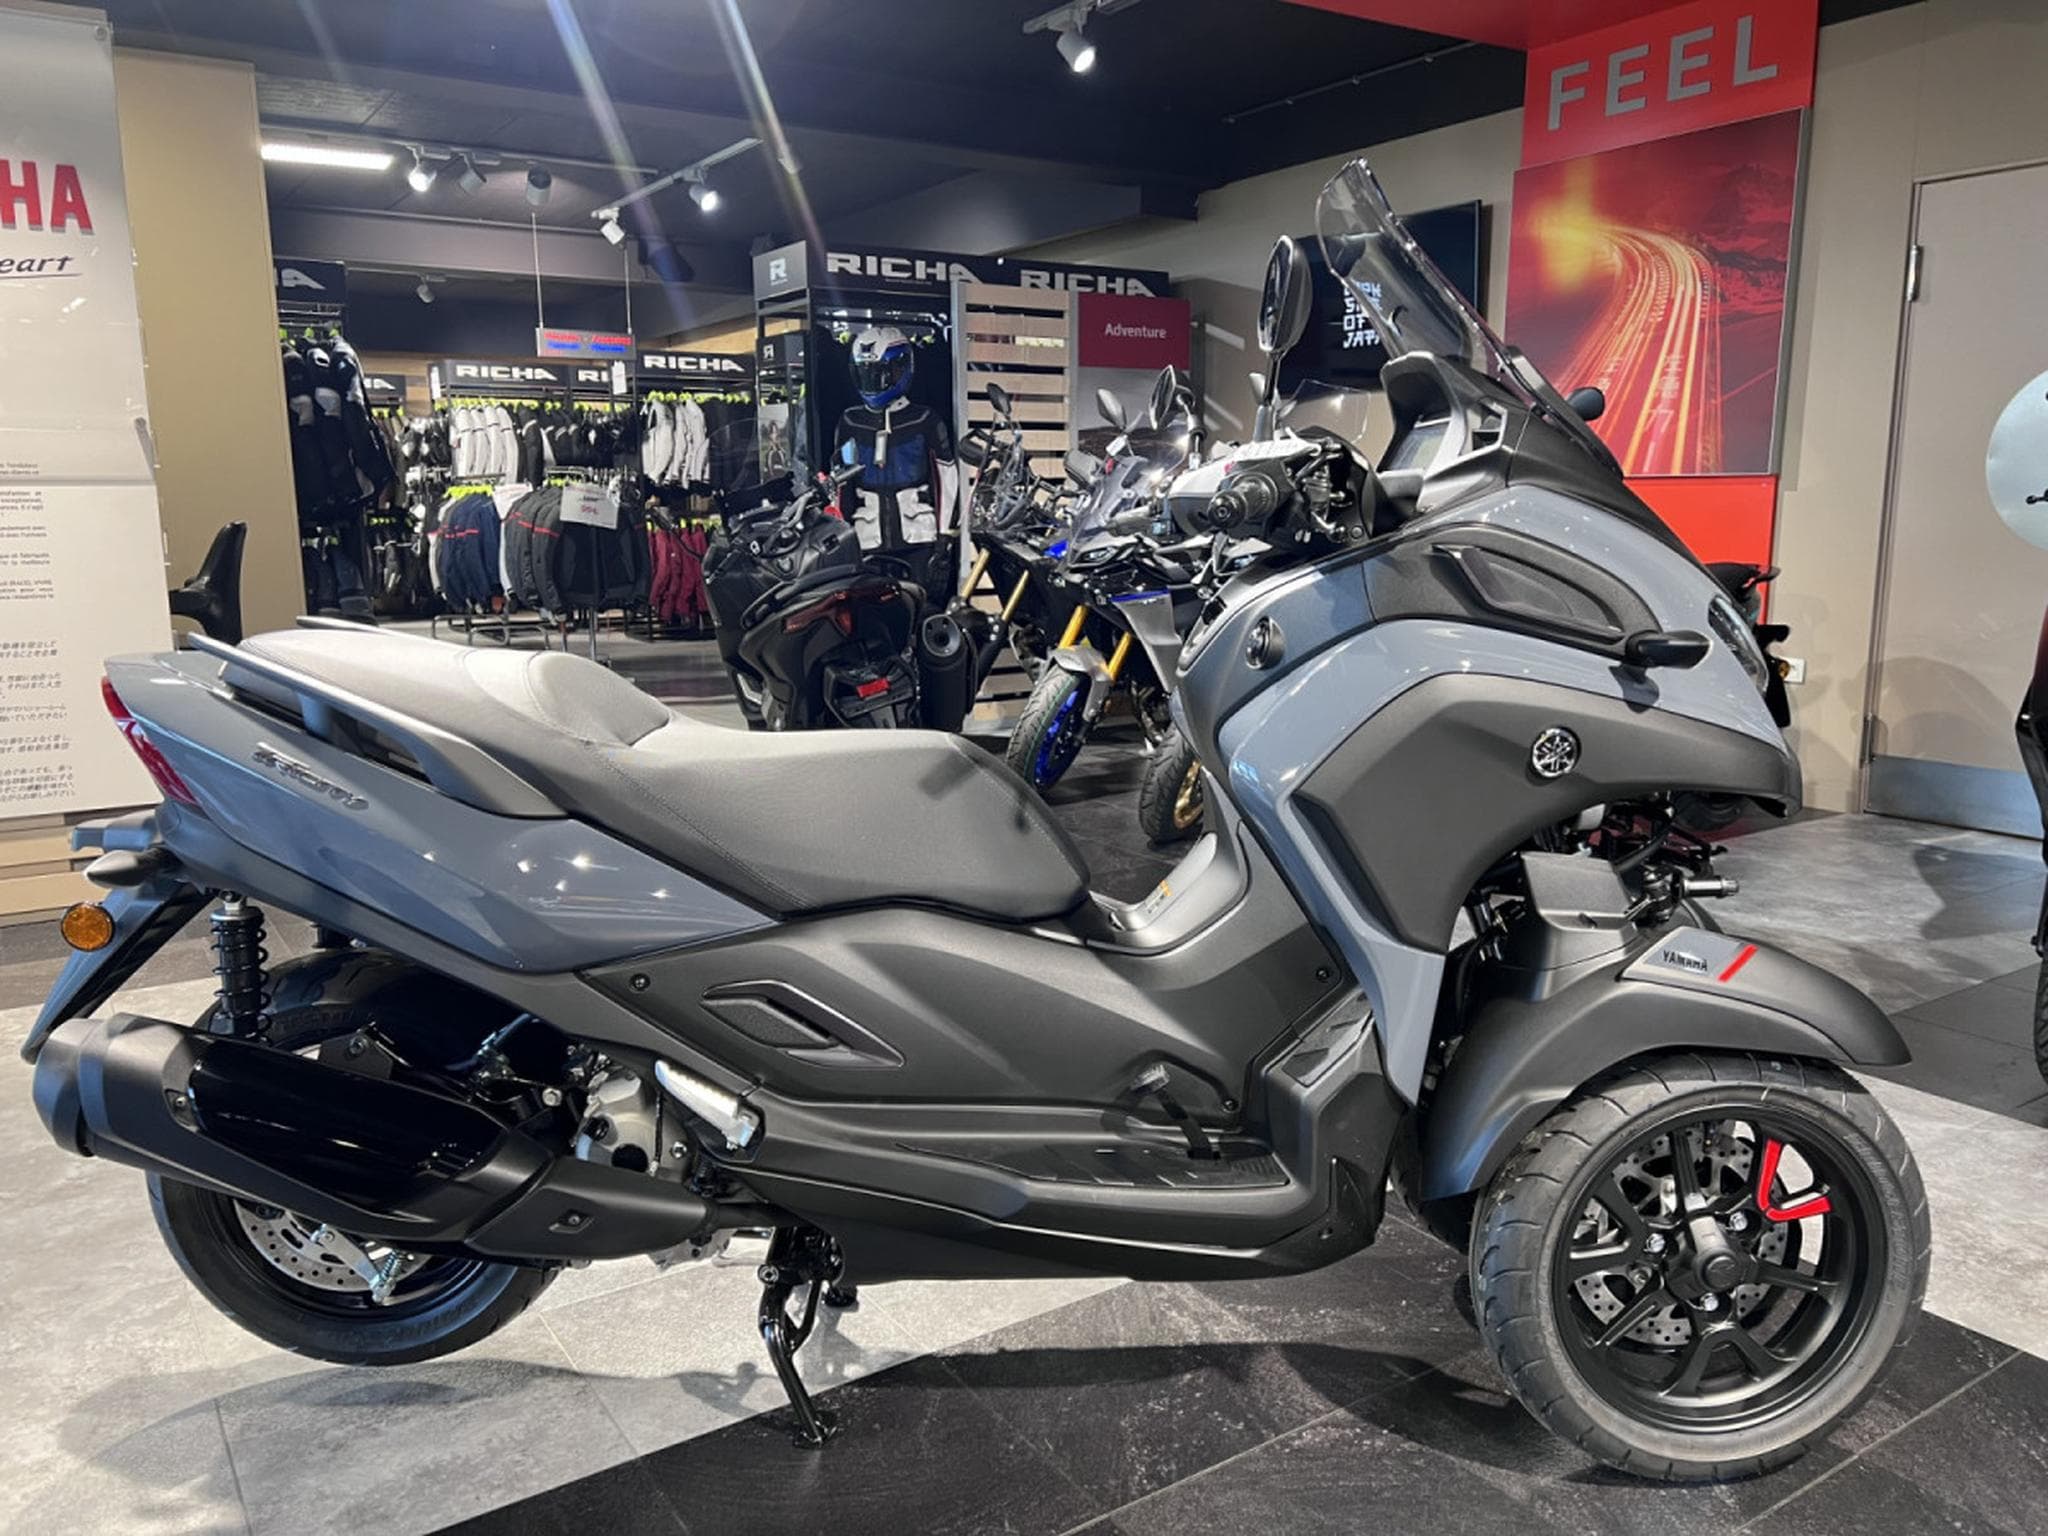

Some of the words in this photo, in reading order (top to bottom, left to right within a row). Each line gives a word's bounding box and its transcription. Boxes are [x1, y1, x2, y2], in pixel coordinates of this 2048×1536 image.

[1547, 15, 1779, 131] FEEL
[827, 252, 984, 285] RICHA
[1020, 269, 1156, 298] RICHA
[1104, 322, 1168, 340] Adventure
[1342, 329, 1380, 348] JAP
[456, 364, 558, 381] RICHA
[643, 355, 745, 372] RICHA
[578, 369, 609, 383] RI
[1663, 949, 1708, 972] YAMAHA
